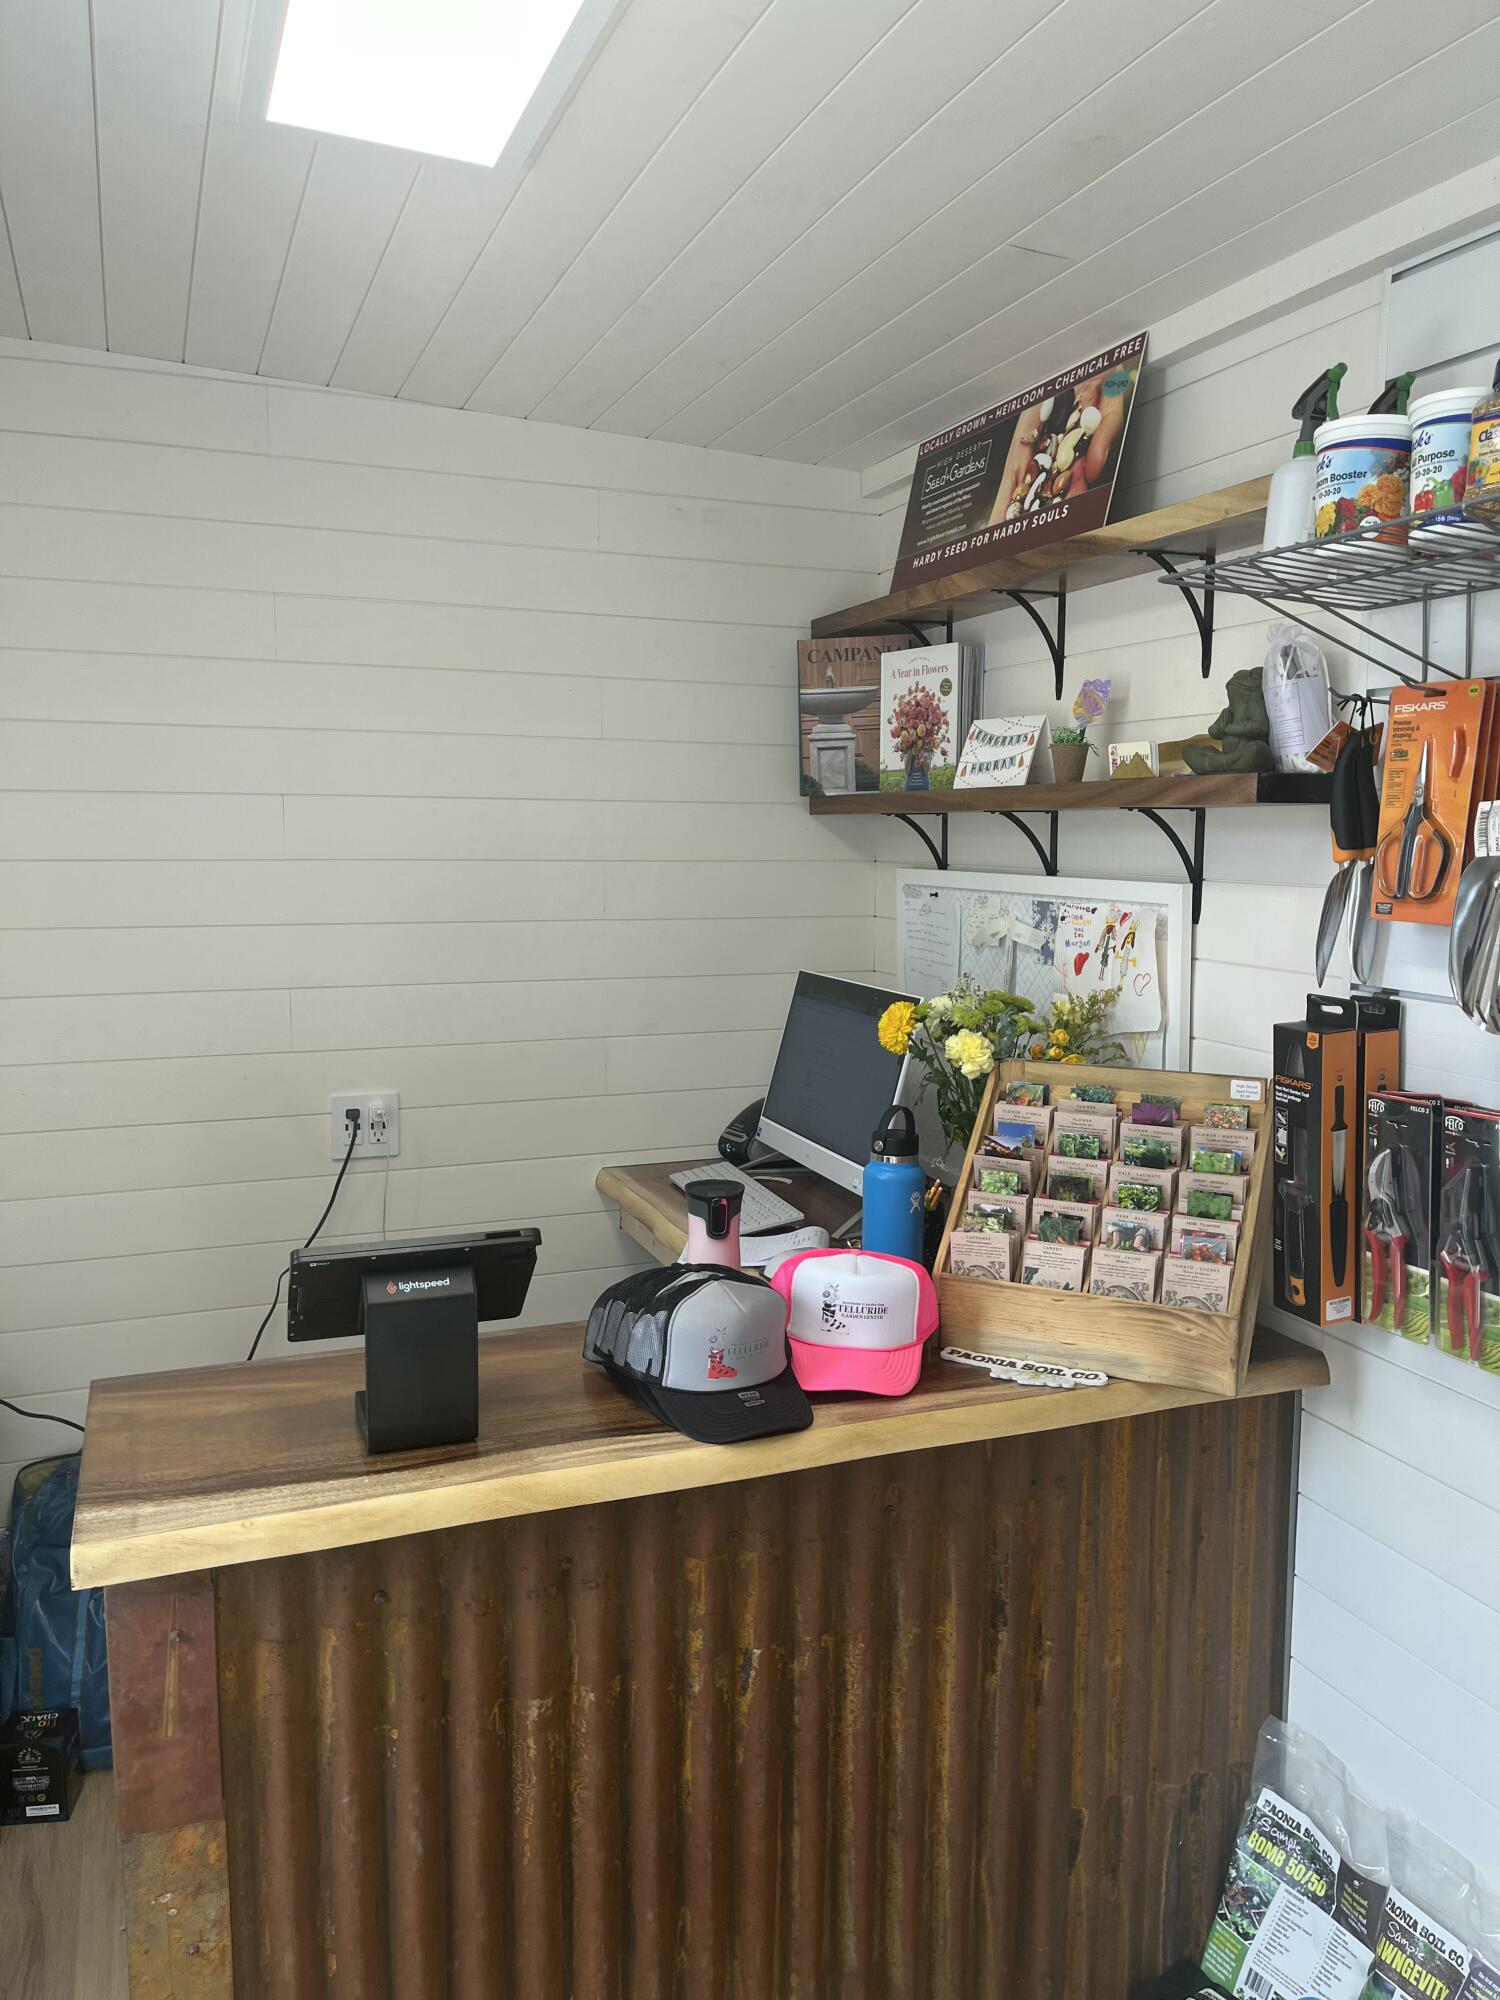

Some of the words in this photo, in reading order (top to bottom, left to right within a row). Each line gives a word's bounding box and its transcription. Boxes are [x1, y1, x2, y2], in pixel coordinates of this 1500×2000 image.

[919, 430, 955, 456] LOCALLY
[955, 414, 987, 438] GROWN
[996, 388, 1044, 419] HEIRLOOM
[1055, 354, 1109, 390] CHEMICAL
[1113, 337, 1142, 361] FREE
[936, 456, 953, 468] HIGH
[956, 442, 981, 460] DESERT
[1417, 449, 1455, 466] Purpose
[1330, 470, 1368, 483] Booster
[913, 549, 943, 569] HARDY
[944, 541, 968, 558] SEED
[970, 533, 990, 549] FOR
[992, 519, 1028, 541] HARDY
[1031, 504, 1069, 528] SOULS
[891, 670, 896, 679] A
[898, 667, 912, 678] Year
[913, 666, 920, 676] in
[921, 664, 949, 676] Flowers
[1394, 701, 1447, 713] FISKARS
[976, 729, 1029, 746] CONGRATS
[971, 757, 1017, 774] HOORAY
[1275, 1074, 1312, 1090] FISKARS
[1368, 1098, 1385, 1113] FELCO
[1410, 1105, 1425, 1113] FELCO
[1445, 1116, 1464, 1131] FELCO
[398, 1277, 450, 1293] lightspeed
[839, 1304, 889, 1315] TELLURIDE
[948, 1349, 1017, 1368] PAONIA
[1020, 1363, 1067, 1377] SOIL
[1071, 1371, 1102, 1381] CO.
[21, 1712, 59, 1723] CHALK
[1258, 1817, 1301, 1855] Sample
[1262, 1799, 1302, 1834] PAONIA
[1303, 1827, 1322, 1853] SOIL
[1322, 1849, 1334, 1869] CO.
[1247, 1830, 1287, 1868] BOMB
[1285, 1857, 1327, 1897] 50/50
[1385, 1897, 1419, 1934] PAONIA
[1419, 1926, 1448, 1954] SOIL
[1448, 1948, 1465, 1971] CO.
[1387, 1921, 1425, 1961] Sample
